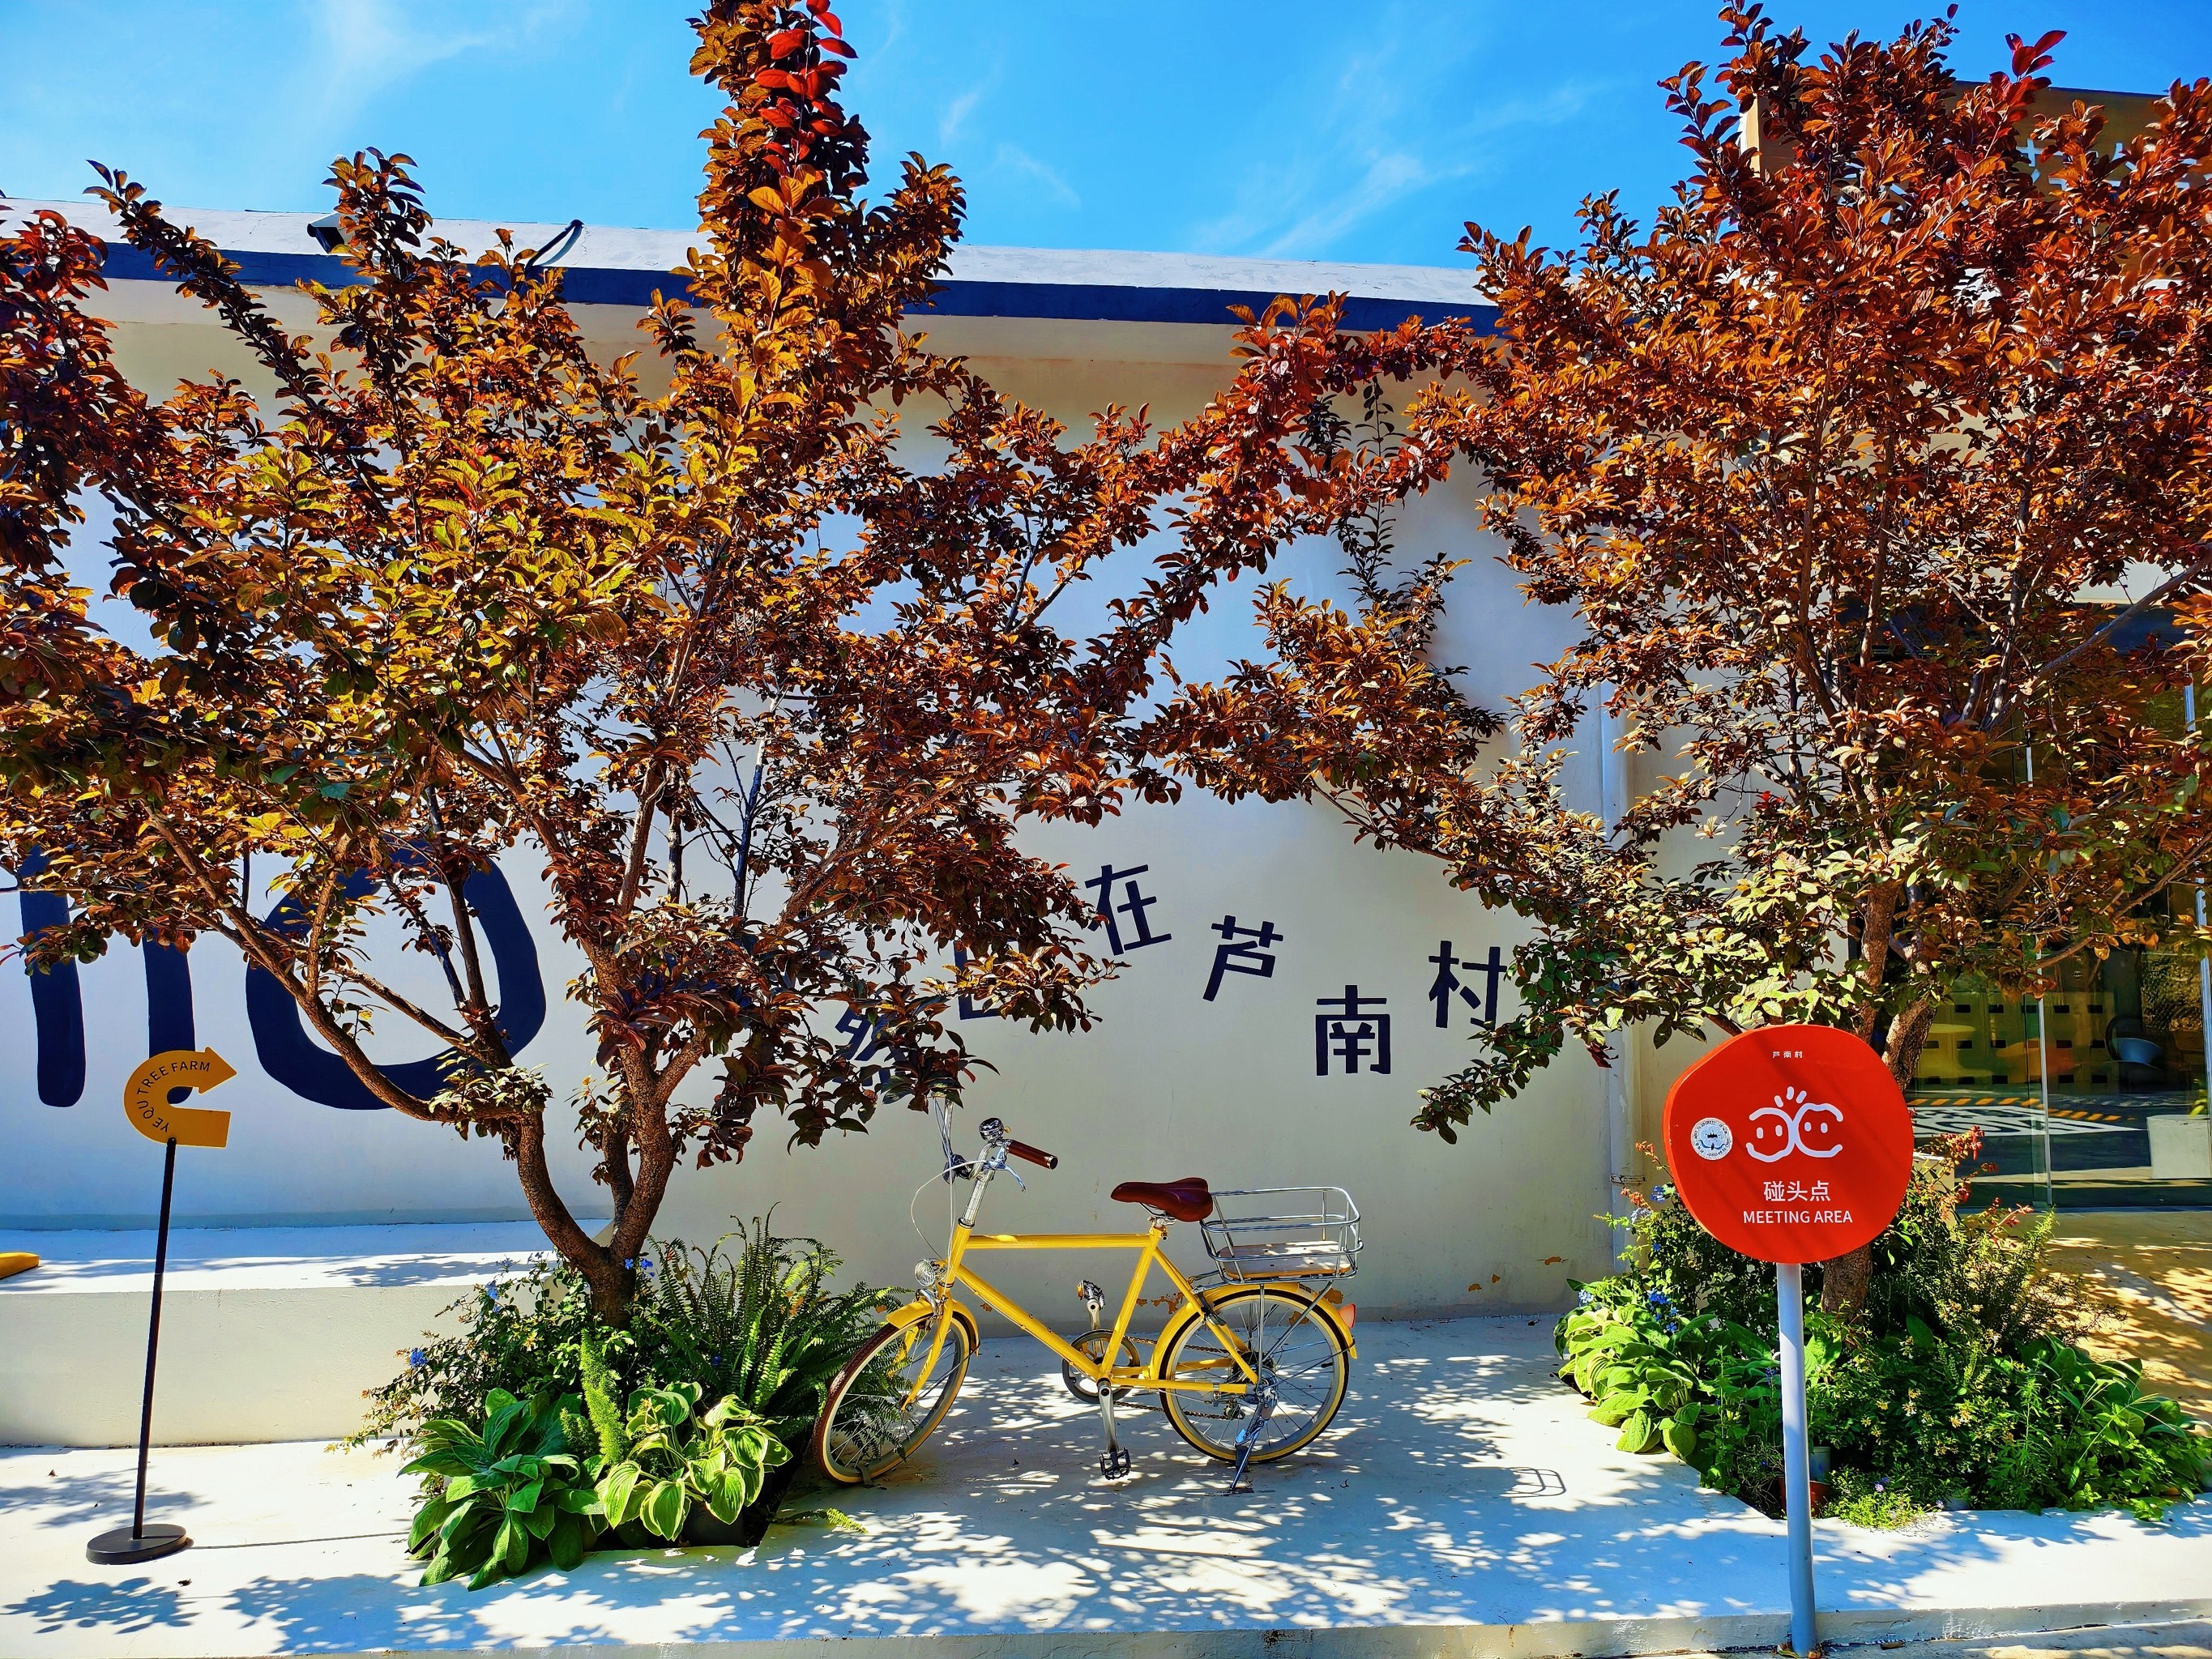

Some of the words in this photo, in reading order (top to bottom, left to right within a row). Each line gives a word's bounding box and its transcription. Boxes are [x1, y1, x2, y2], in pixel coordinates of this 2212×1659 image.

[171, 1060, 210, 1073] FARM
[137, 1065, 169, 1095] TREE
[137, 1100, 155, 1120] QU
[152, 1117, 169, 1132] YE
[1763, 1179, 1831, 1202] 碰头点
[1743, 1210, 1811, 1224] MEETING
[1813, 1210, 1853, 1223] AREA
